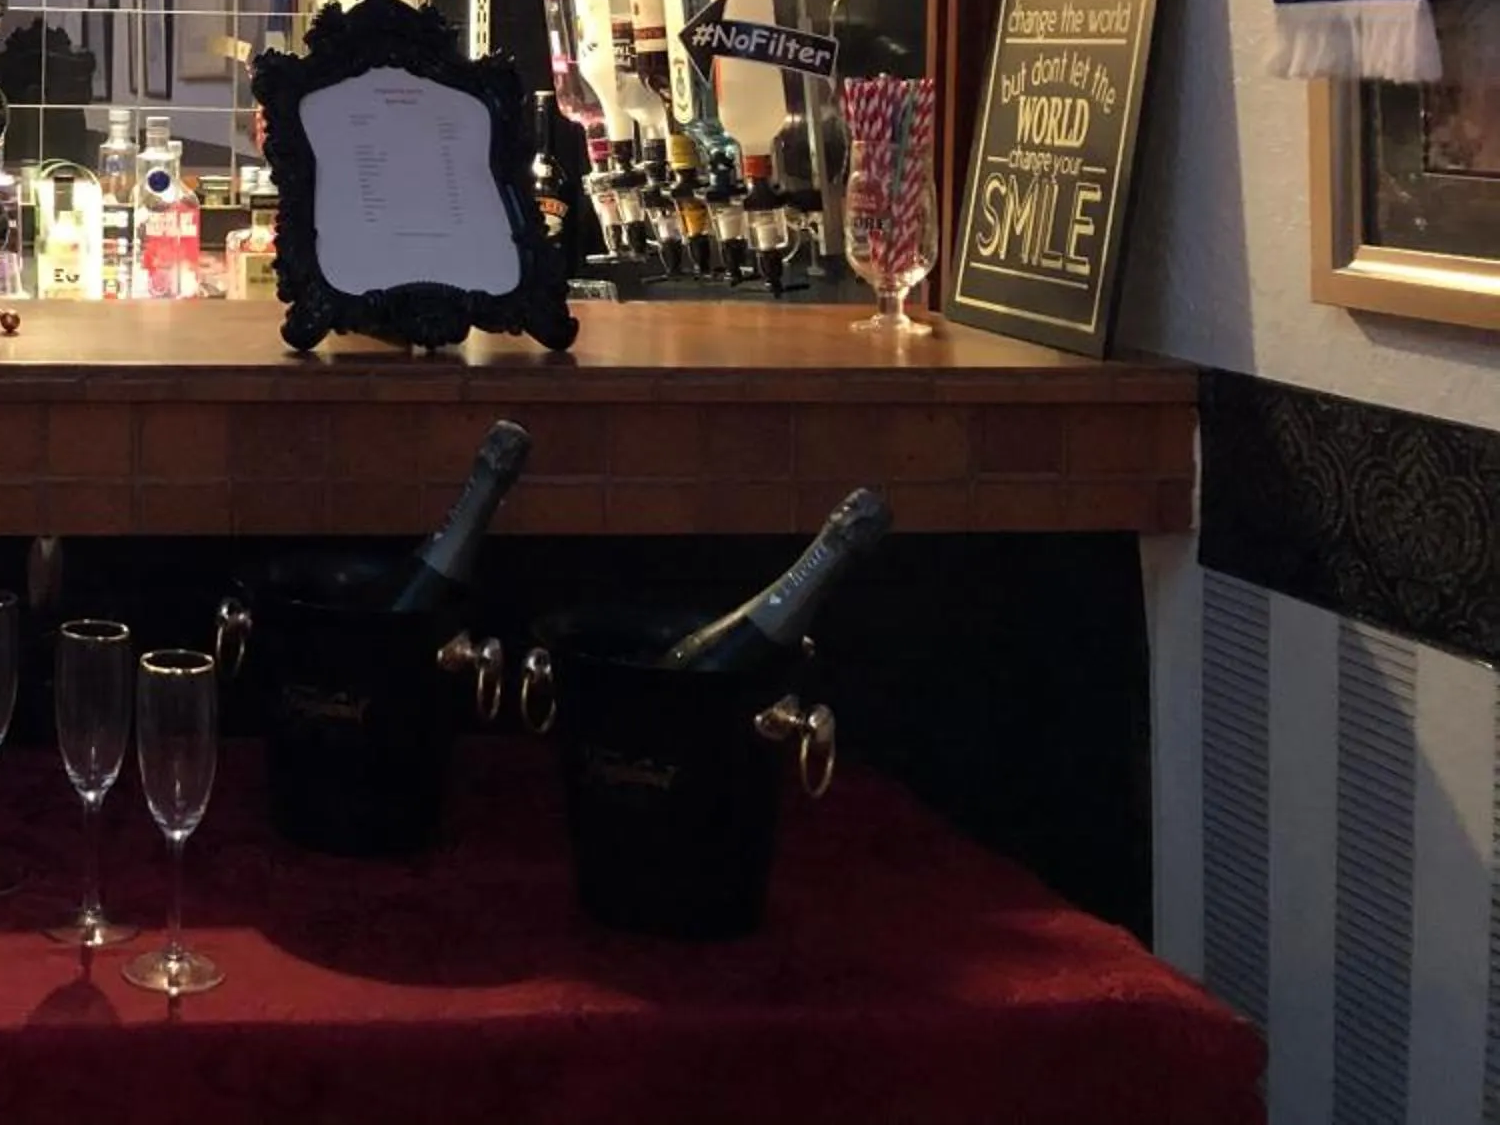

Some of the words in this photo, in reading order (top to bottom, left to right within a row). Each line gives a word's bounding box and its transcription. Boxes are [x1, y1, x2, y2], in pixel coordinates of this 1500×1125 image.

[692, 22, 832, 67] #NoFilter
[1007, 0, 1057, 40] change
[1060, 2, 1085, 33] the
[1088, 1, 1132, 33] world
[1002, 61, 1027, 104] but
[1031, 49, 1068, 86] dont
[1069, 52, 1091, 90] let
[1092, 63, 1117, 114] the
[1016, 95, 1090, 148] WORLD
[1008, 145, 1052, 175] change
[1051, 154, 1084, 179] your
[975, 172, 1103, 275] SMILE
